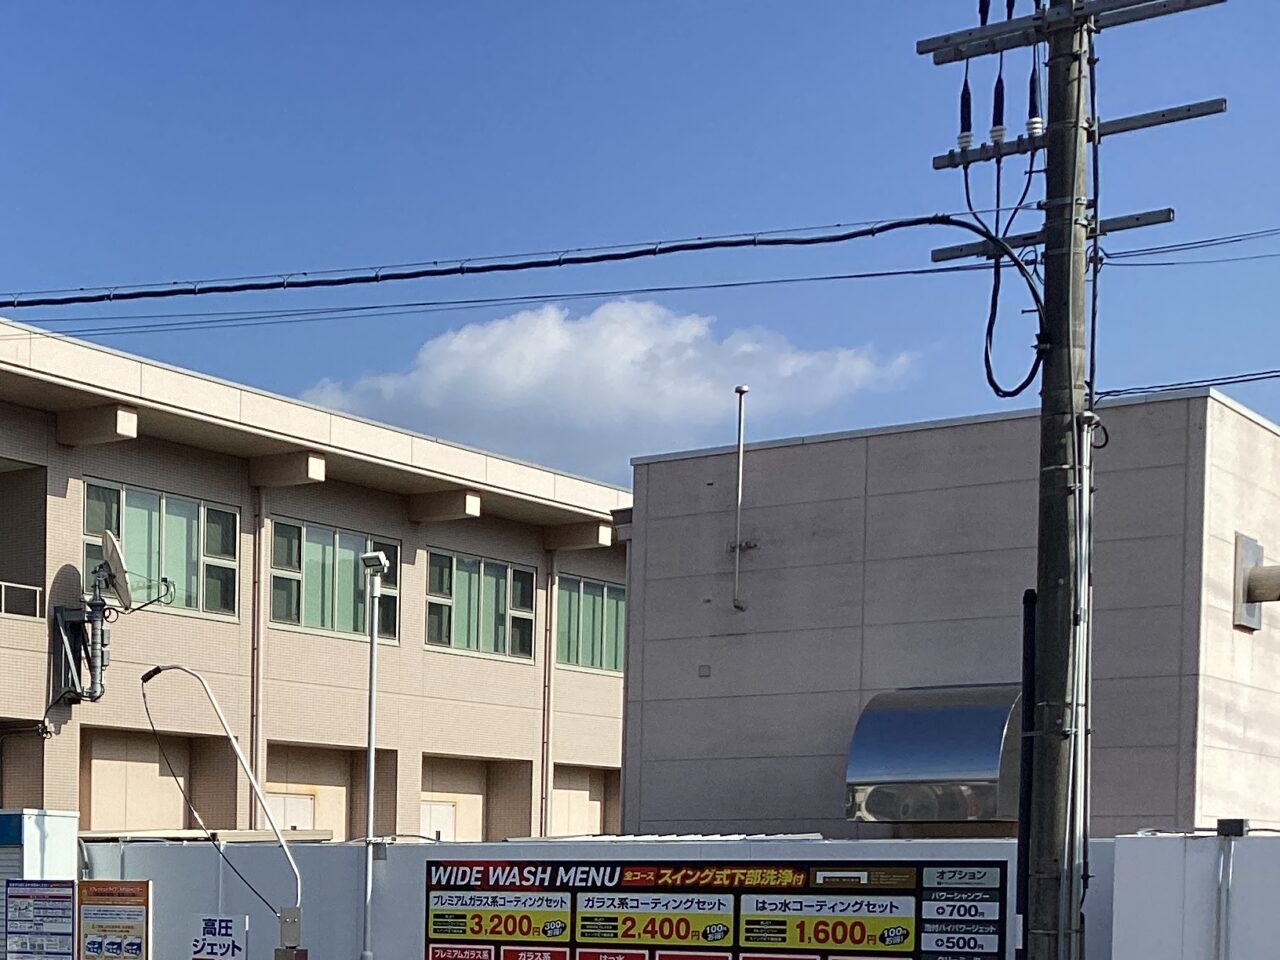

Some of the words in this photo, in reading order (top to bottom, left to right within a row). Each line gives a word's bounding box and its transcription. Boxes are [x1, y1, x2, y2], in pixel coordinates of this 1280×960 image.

[431, 866, 484, 886] WIDE
[488, 866, 552, 886] WASH
[556, 866, 620, 887] MENU
[623, 871, 655, 881] 全コース
[936, 870, 987, 880] オプション
[433, 895, 567, 908] プレミアムガラス系コーティングセット
[931, 892, 990, 900] パワーシャンプー
[584, 897, 727, 911] ガラス系コーティングセット
[755, 899, 899, 914] はっ水コーティングセット
[202, 918, 233, 937] 高圧
[470, 913, 540, 936] 3,200円
[621, 916, 700, 941] 2,400円
[795, 920, 877, 945] 1,600円
[192, 938, 242, 957] ジェット
[434, 949, 489, 960] プレミアムガラス系
[518, 952, 551, 960] ガラス系
